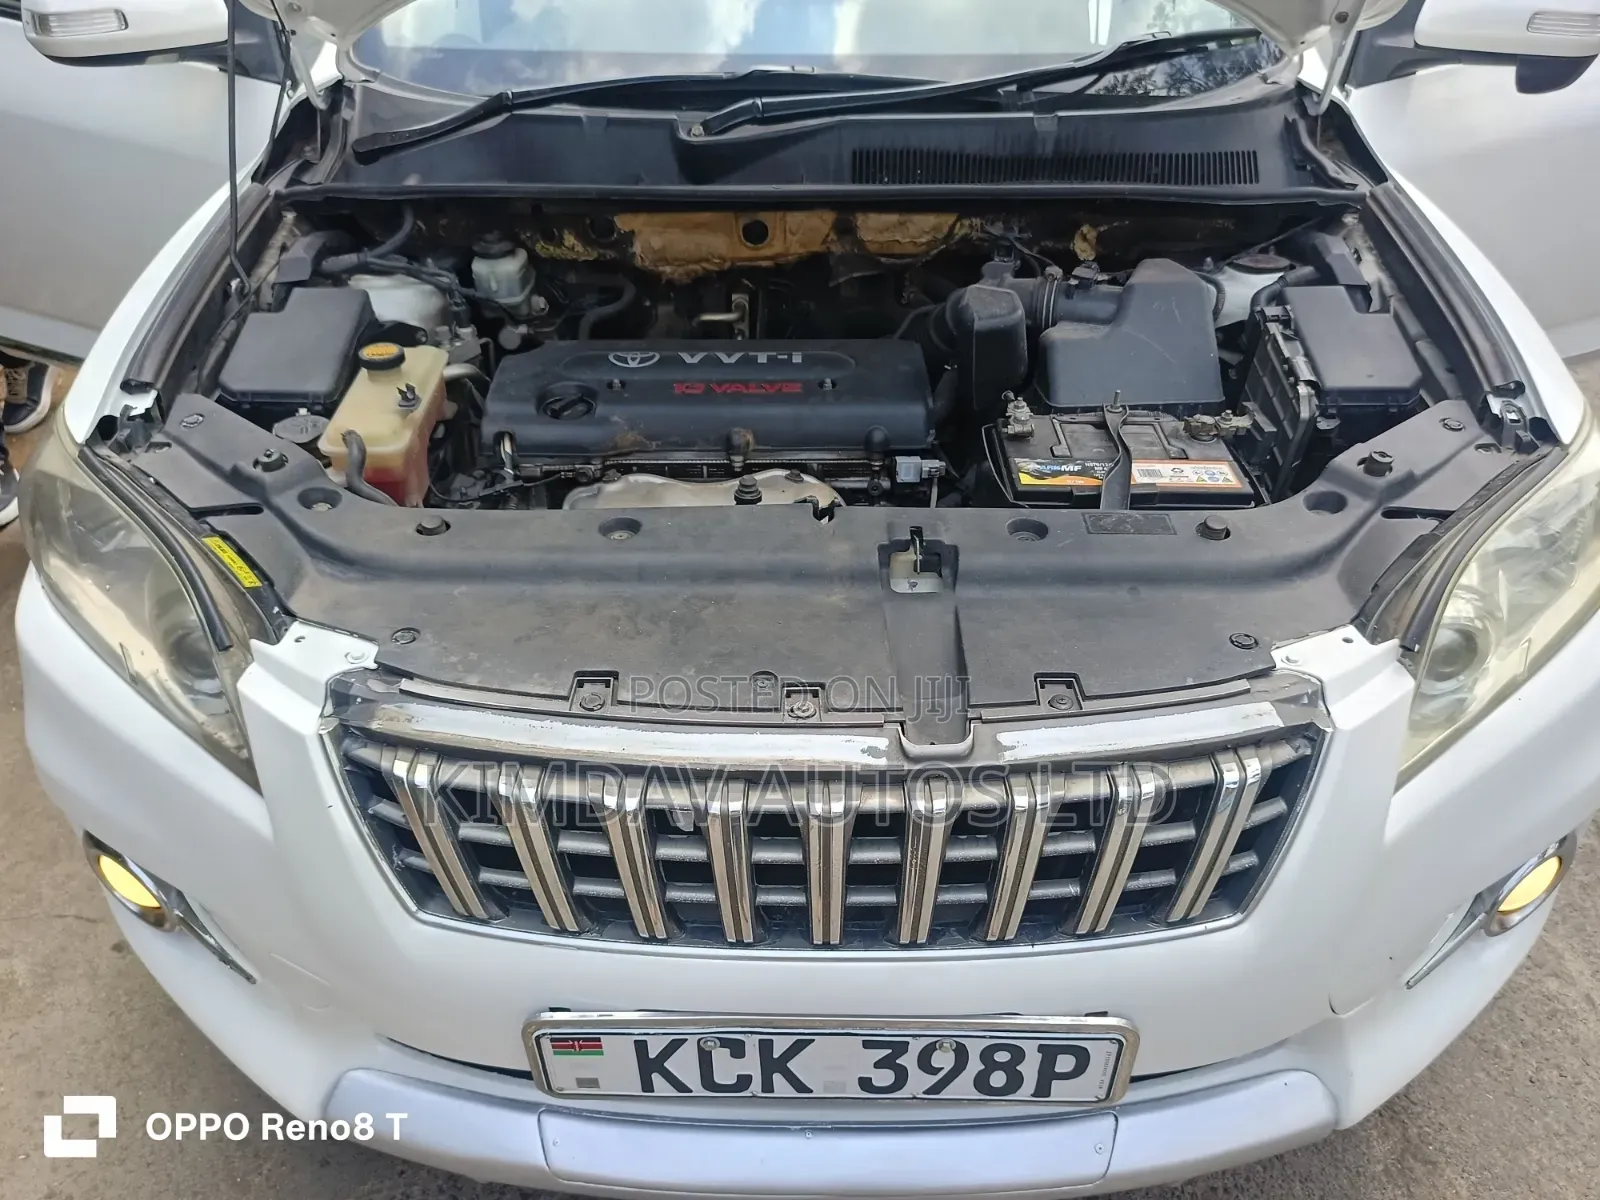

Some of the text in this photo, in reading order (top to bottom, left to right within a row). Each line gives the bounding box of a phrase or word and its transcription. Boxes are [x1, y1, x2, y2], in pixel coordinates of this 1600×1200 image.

[708, 382, 803, 394] VALVE
[633, 1038, 815, 1094] KCK
[857, 1039, 1091, 1098] 398P
